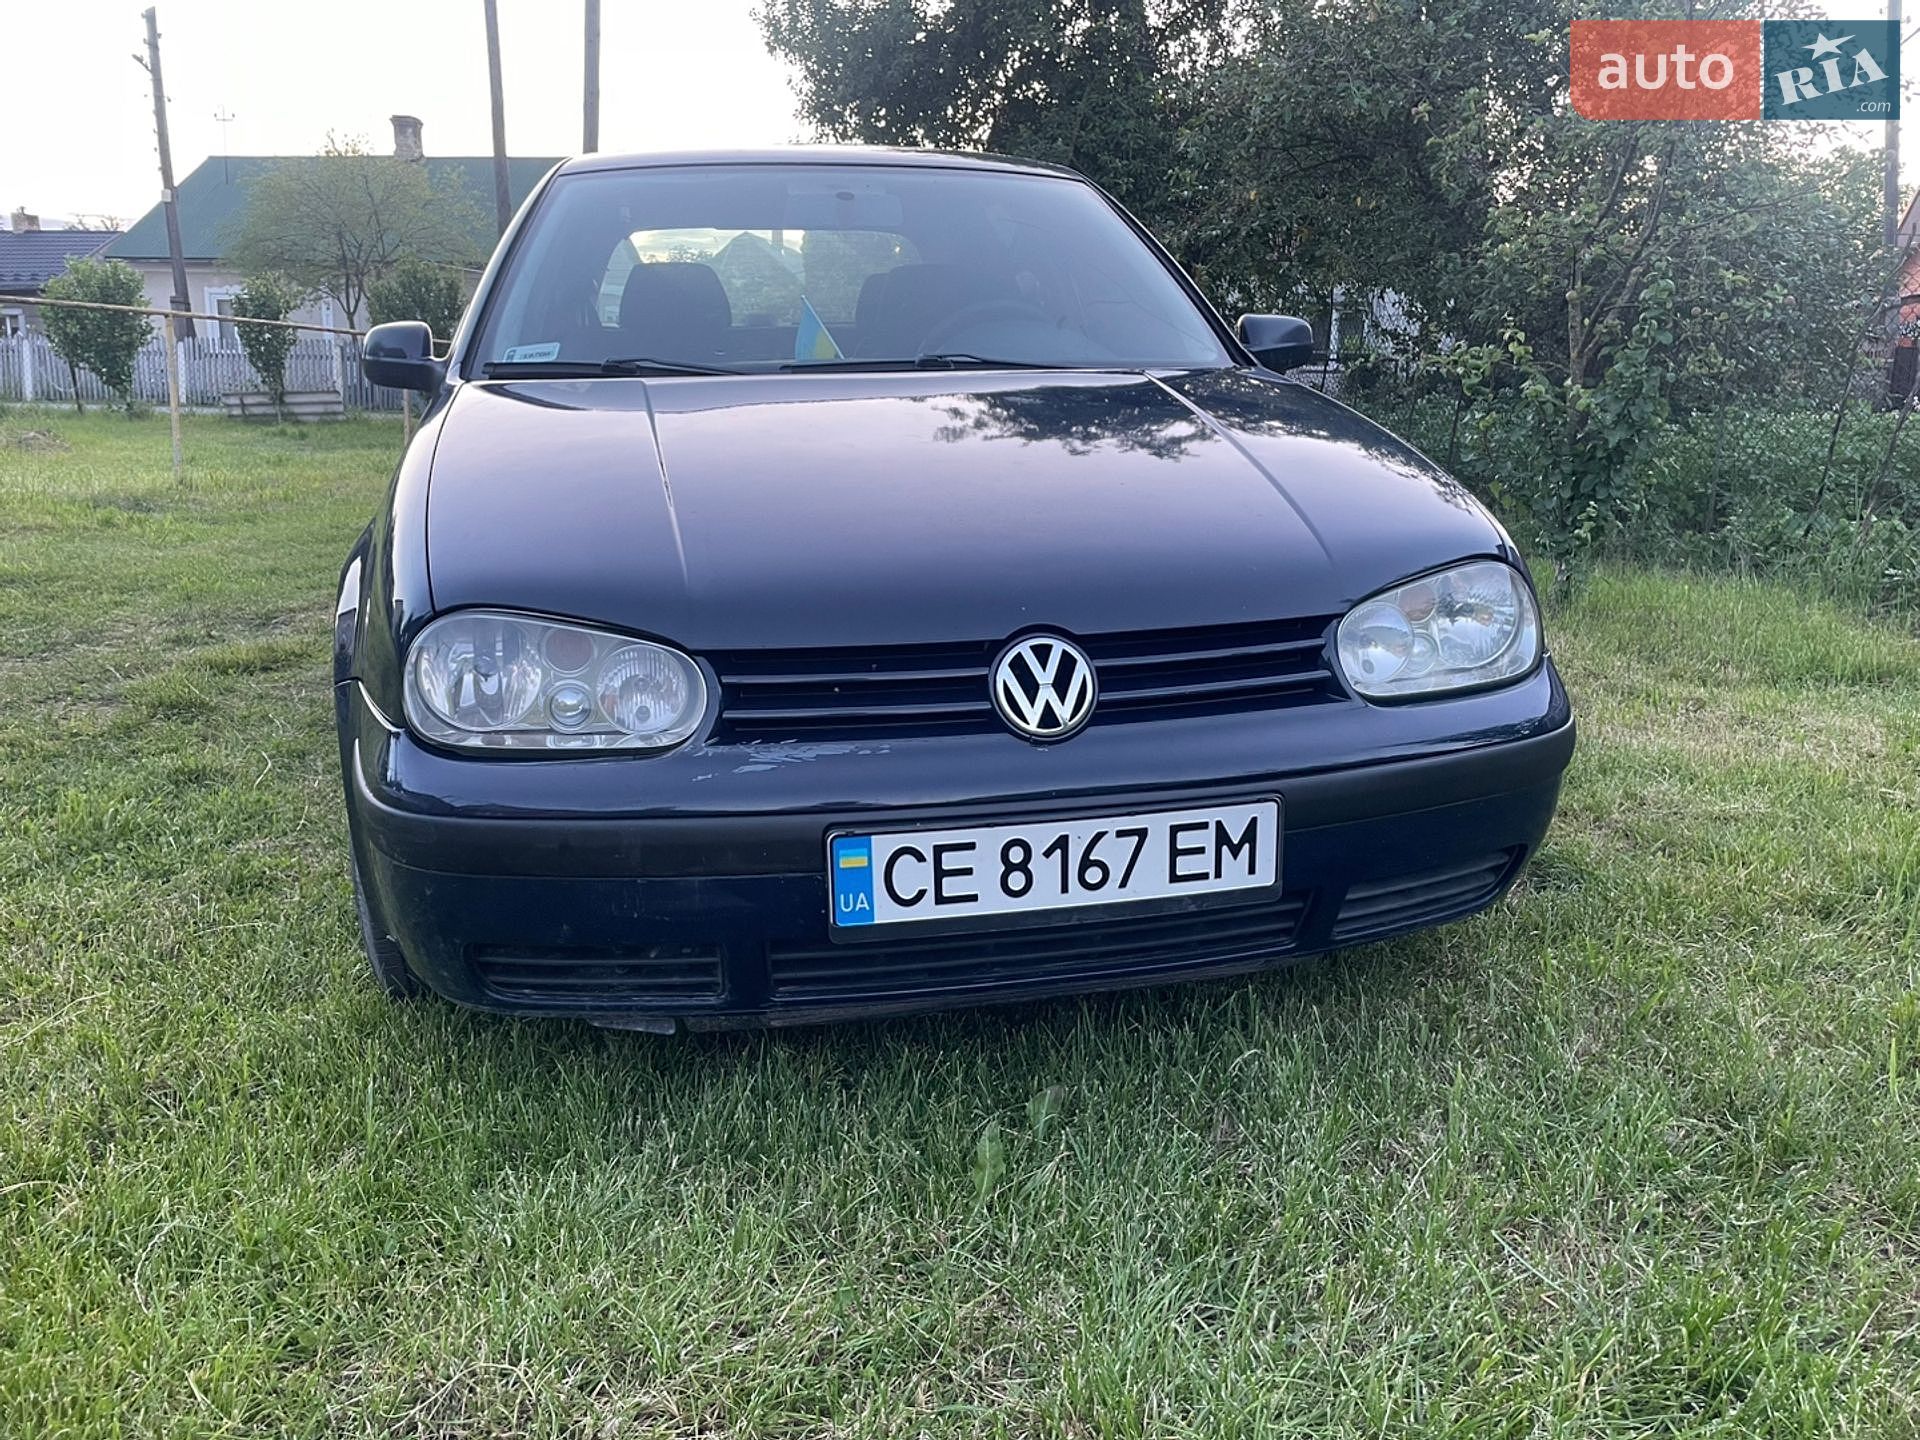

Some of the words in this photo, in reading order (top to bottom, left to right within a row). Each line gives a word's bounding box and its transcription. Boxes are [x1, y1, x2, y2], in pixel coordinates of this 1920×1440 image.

[883, 841, 979, 907] CE
[999, 827, 1149, 898] 8167
[1168, 815, 1258, 884] EM
[840, 892, 870, 912] UA
